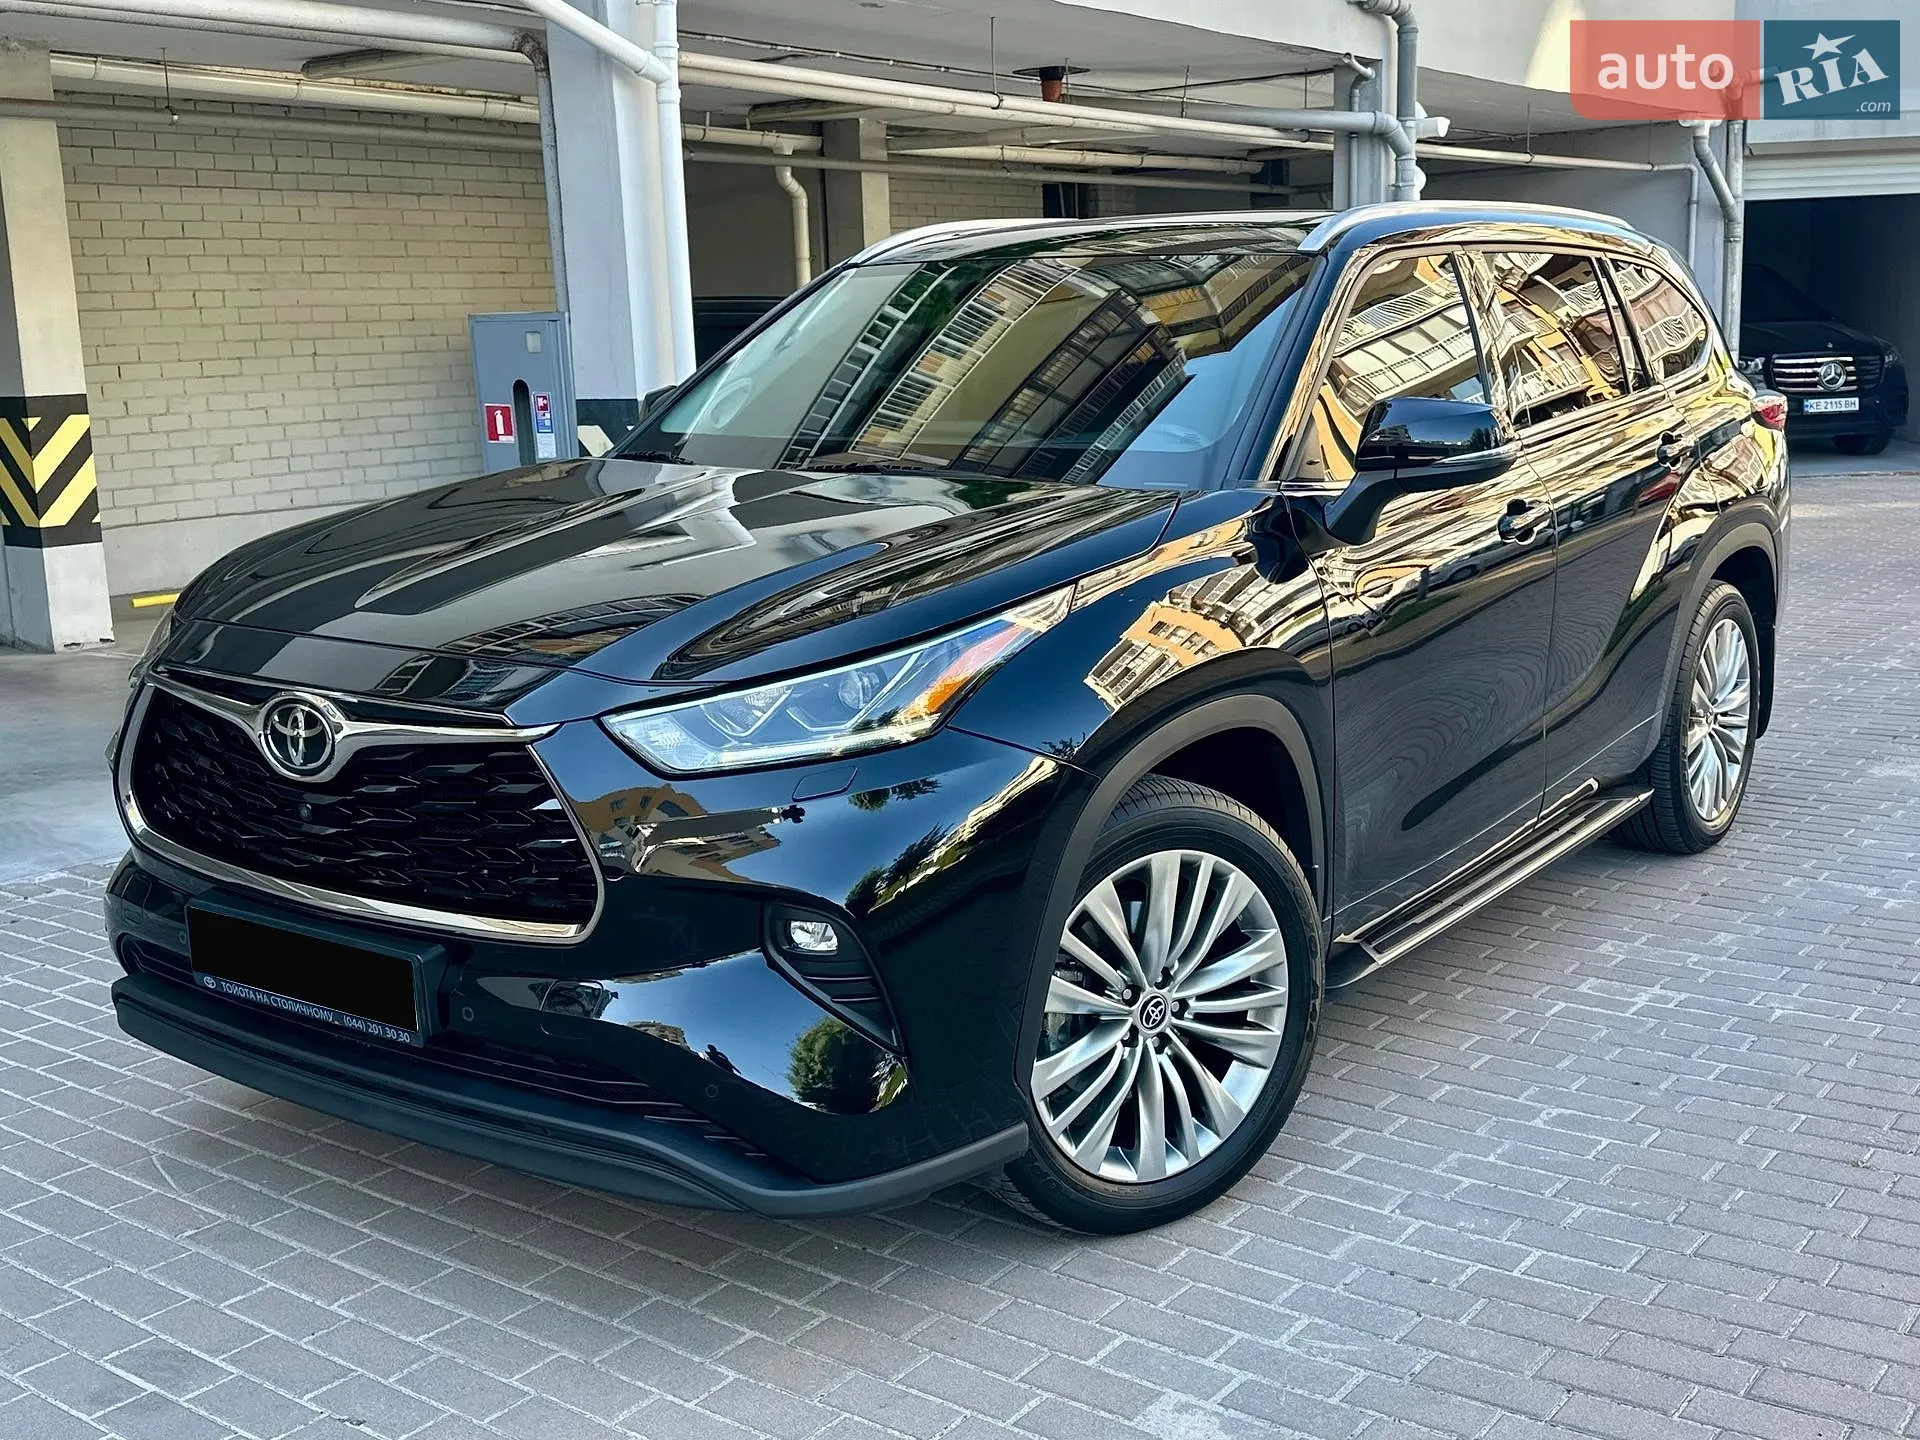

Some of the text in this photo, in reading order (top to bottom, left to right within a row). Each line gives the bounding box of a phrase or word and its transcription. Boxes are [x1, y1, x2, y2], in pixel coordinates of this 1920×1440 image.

[1809, 401, 1822, 411] KE
[1823, 400, 1843, 410] 2115
[220, 981, 411, 1043] ТОЙОТА НА СТОЛИЧНОМУ (044) 201 30 30
